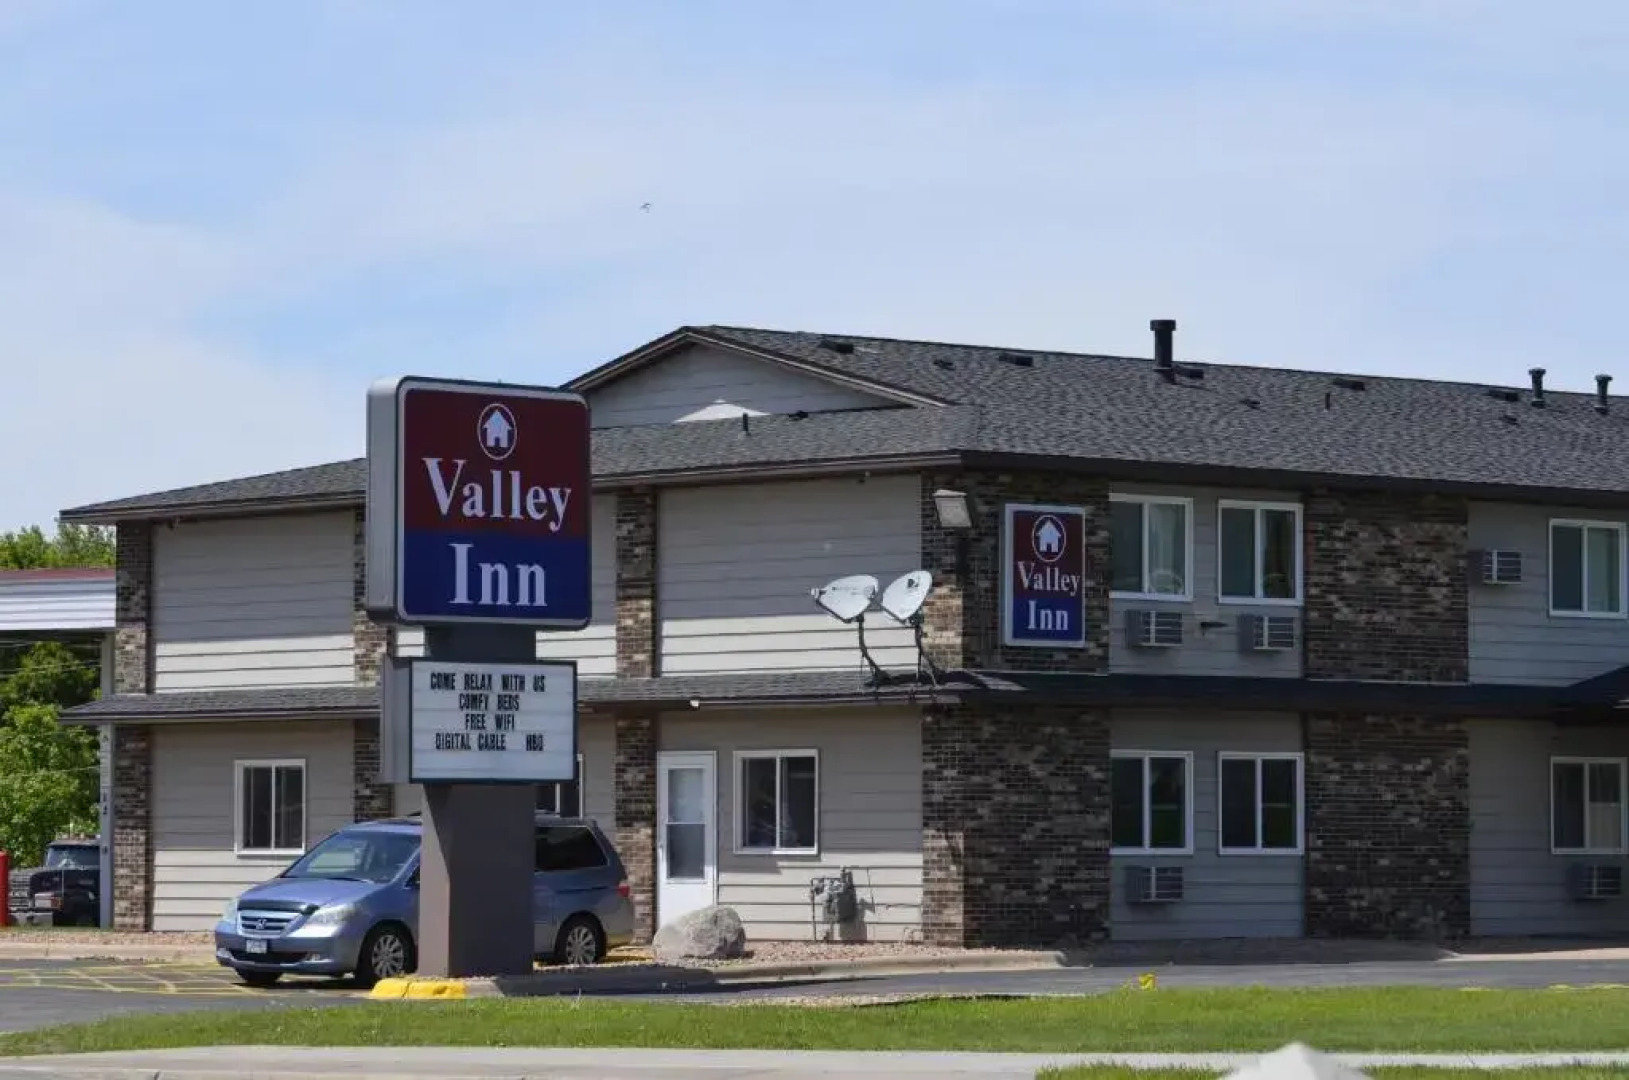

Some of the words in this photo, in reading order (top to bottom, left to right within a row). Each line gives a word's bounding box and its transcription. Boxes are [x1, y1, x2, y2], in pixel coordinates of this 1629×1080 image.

[422, 457, 572, 532] Valley
[448, 543, 548, 606] Inn
[1018, 561, 1080, 597] Valley
[1027, 600, 1069, 631] Inn
[430, 672, 456, 690] COME
[464, 674, 492, 691] RELAX
[502, 674, 525, 692] WITH
[533, 675, 546, 692] US
[459, 693, 489, 710] COMFY
[497, 694, 520, 711] BEDS
[465, 714, 486, 730] FREE
[495, 714, 515, 731] WIFI
[435, 733, 471, 750] DIGITAL
[478, 734, 506, 750] CABLE
[526, 735, 544, 751] HBO
